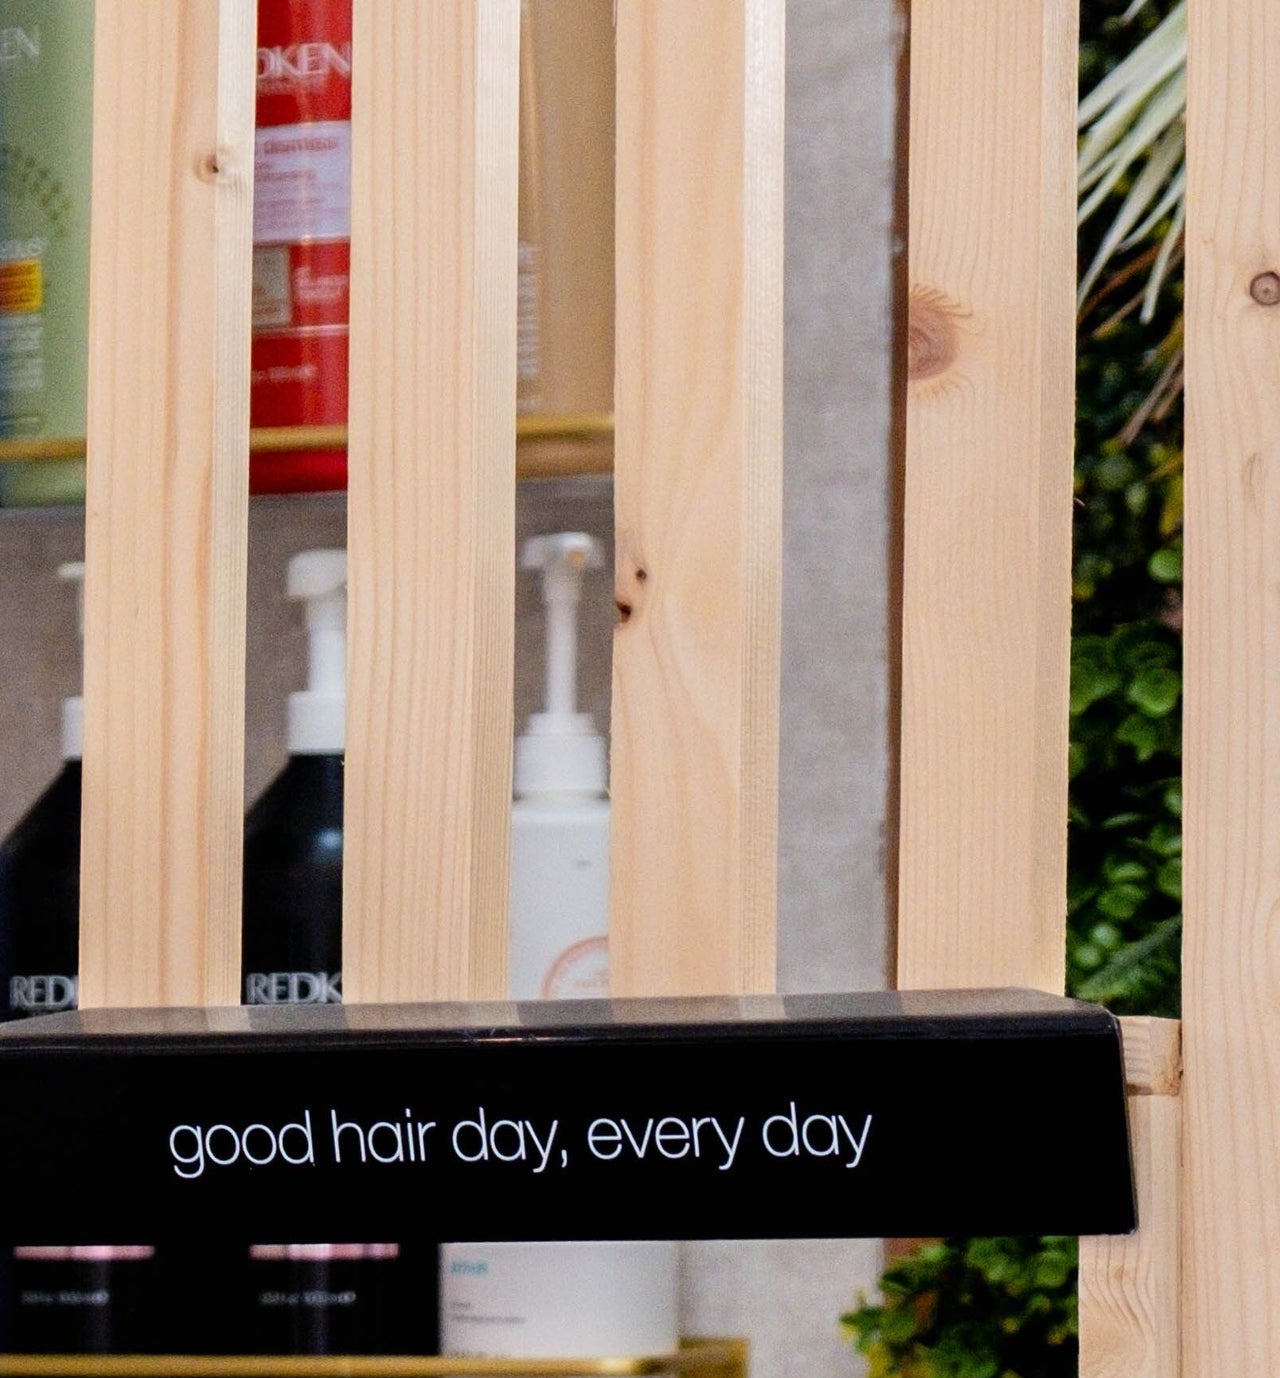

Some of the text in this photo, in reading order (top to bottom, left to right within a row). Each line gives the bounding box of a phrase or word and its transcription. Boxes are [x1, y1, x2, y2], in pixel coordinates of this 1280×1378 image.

[10, 975, 78, 1008] RED
[169, 1101, 872, 1178] good hair day, every day
